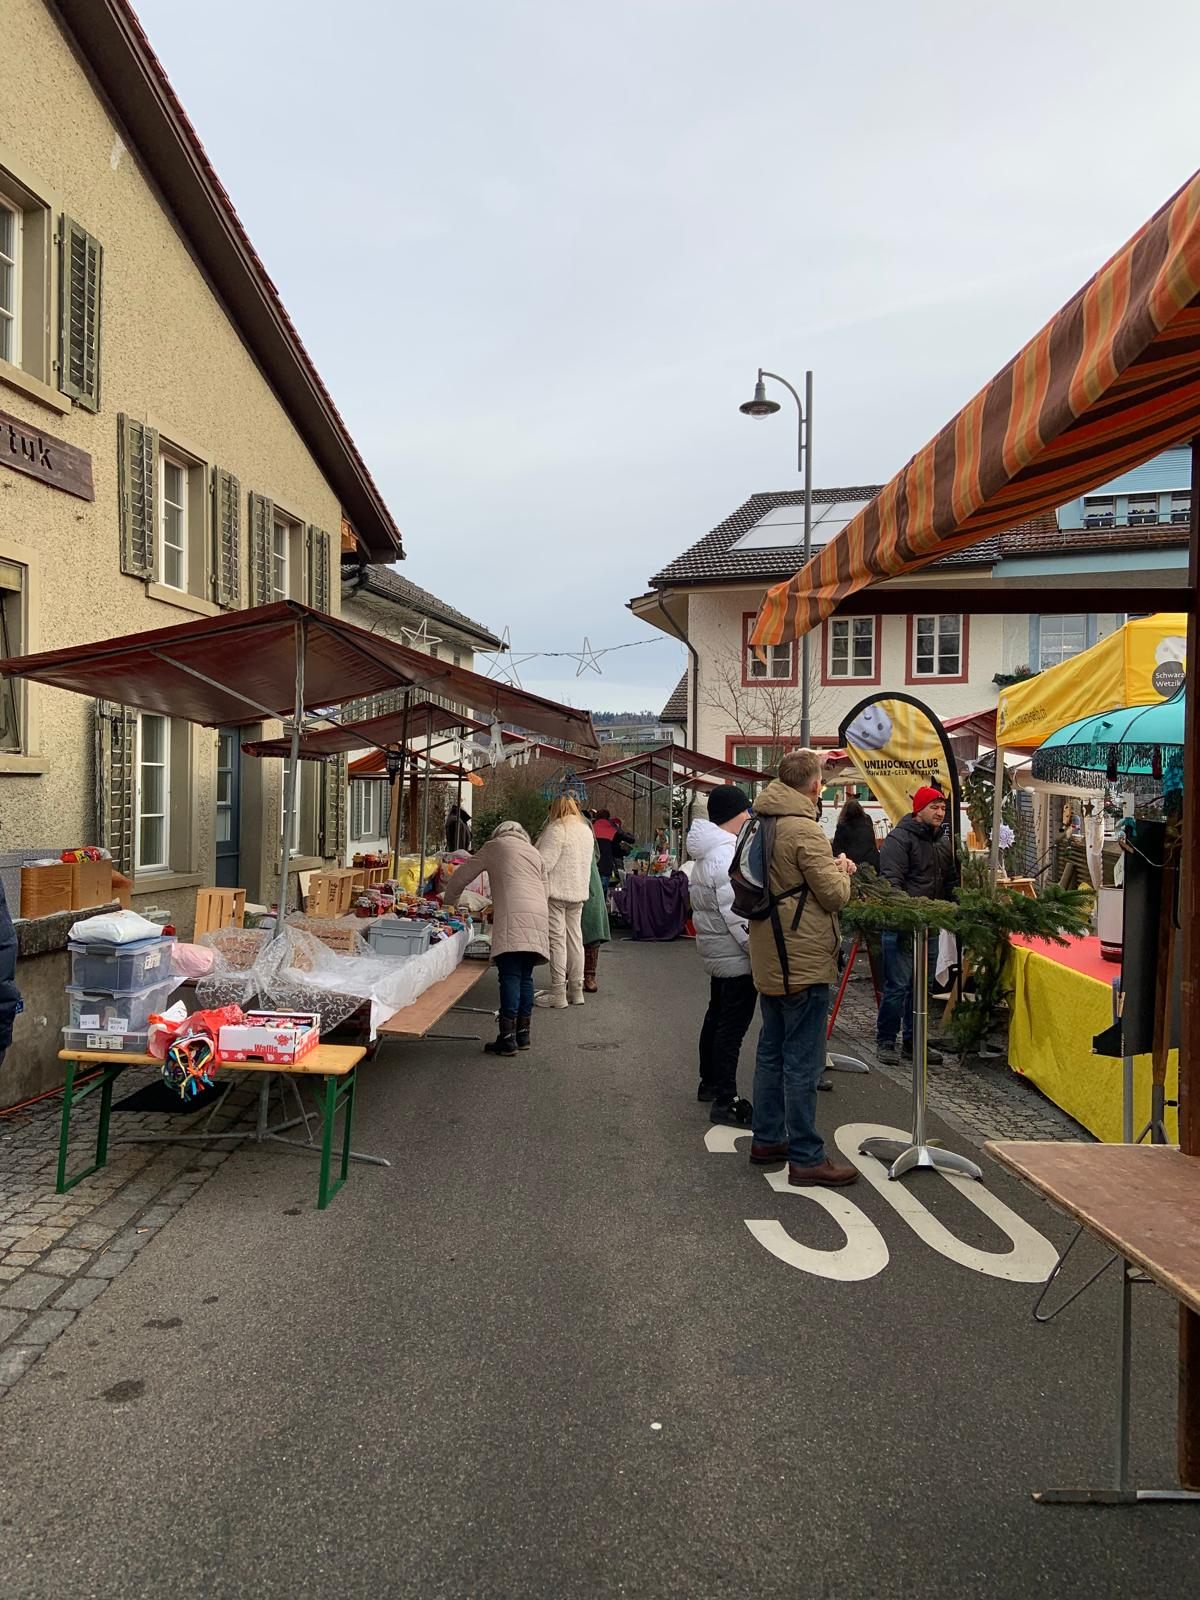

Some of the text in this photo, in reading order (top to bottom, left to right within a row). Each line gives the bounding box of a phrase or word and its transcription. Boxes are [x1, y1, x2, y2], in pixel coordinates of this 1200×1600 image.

[0, 424, 53, 471] tuk
[864, 759, 938, 769] UNIHOCKEYCLUB
[704, 1124, 1060, 1283] 30
